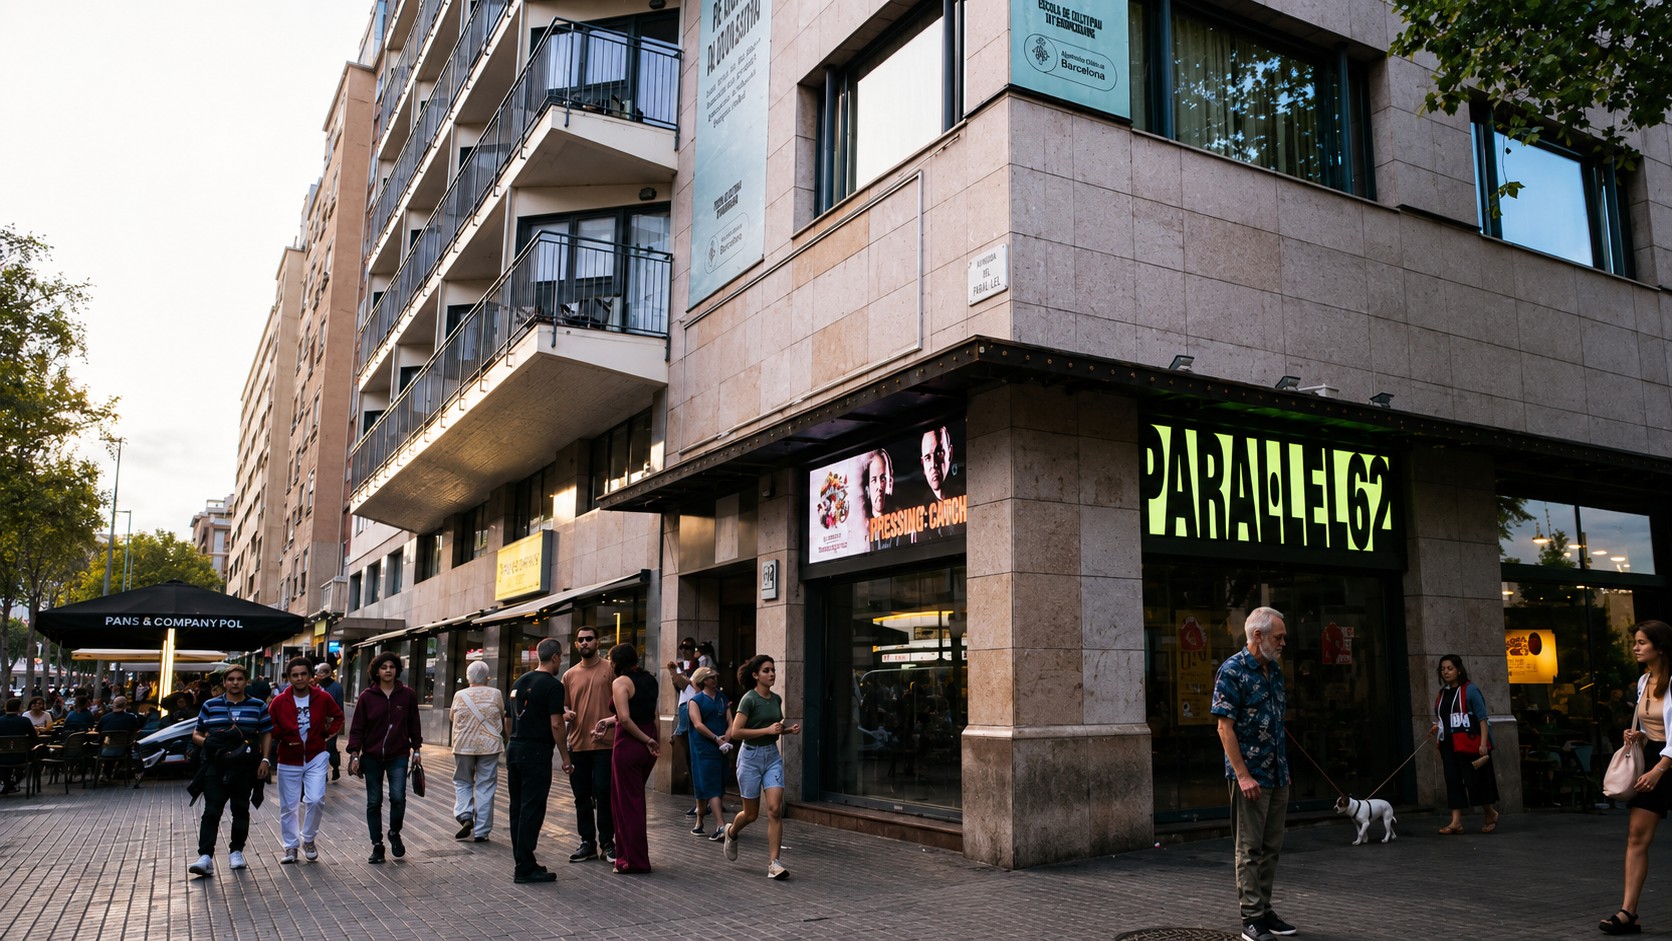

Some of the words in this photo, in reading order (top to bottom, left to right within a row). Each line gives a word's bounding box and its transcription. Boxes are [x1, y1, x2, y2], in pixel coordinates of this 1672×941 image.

[1061, 59, 1106, 81] Barcelona
[928, 495, 967, 530] CATCH
[105, 616, 140, 626] PANS
[142, 616, 152, 626] &
[154, 617, 216, 628] COMPANY
[219, 618, 244, 629] POL
